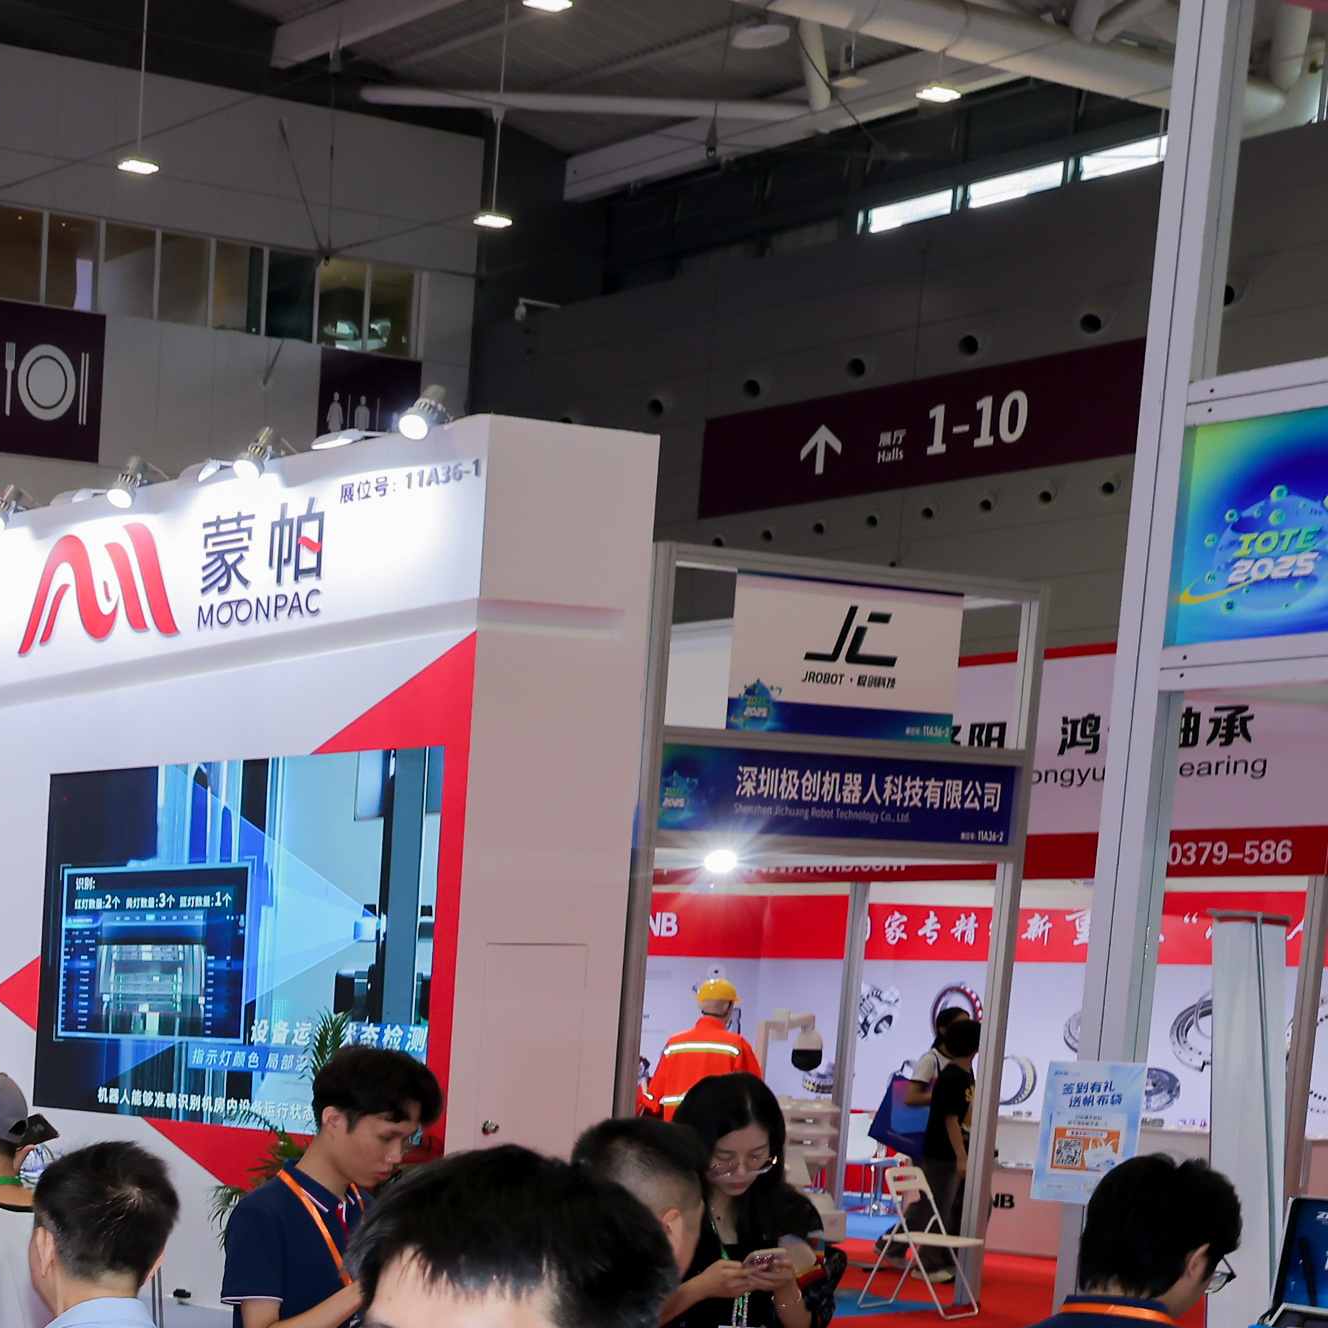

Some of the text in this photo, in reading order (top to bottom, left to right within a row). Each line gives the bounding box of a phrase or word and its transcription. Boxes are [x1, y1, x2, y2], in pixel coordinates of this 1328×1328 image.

[926, 389, 1029, 456] 1-10
[876, 447, 905, 464] Halls
[404, 458, 482, 491] 11A36-1
[200, 496, 326, 596] 蒙帕
[1232, 526, 1322, 557] IOTE
[1227, 550, 1320, 586] 2025
[197, 588, 323, 631] MOONPAC
[800, 671, 845, 686] JROBOT
[1179, 754, 1268, 780] earing
[735, 764, 1003, 813] 深圳极创机器人科技有限公司
[250, 1018, 429, 1053] 设备运状态检测
[192, 1046, 260, 1070] 指示灯颜色
